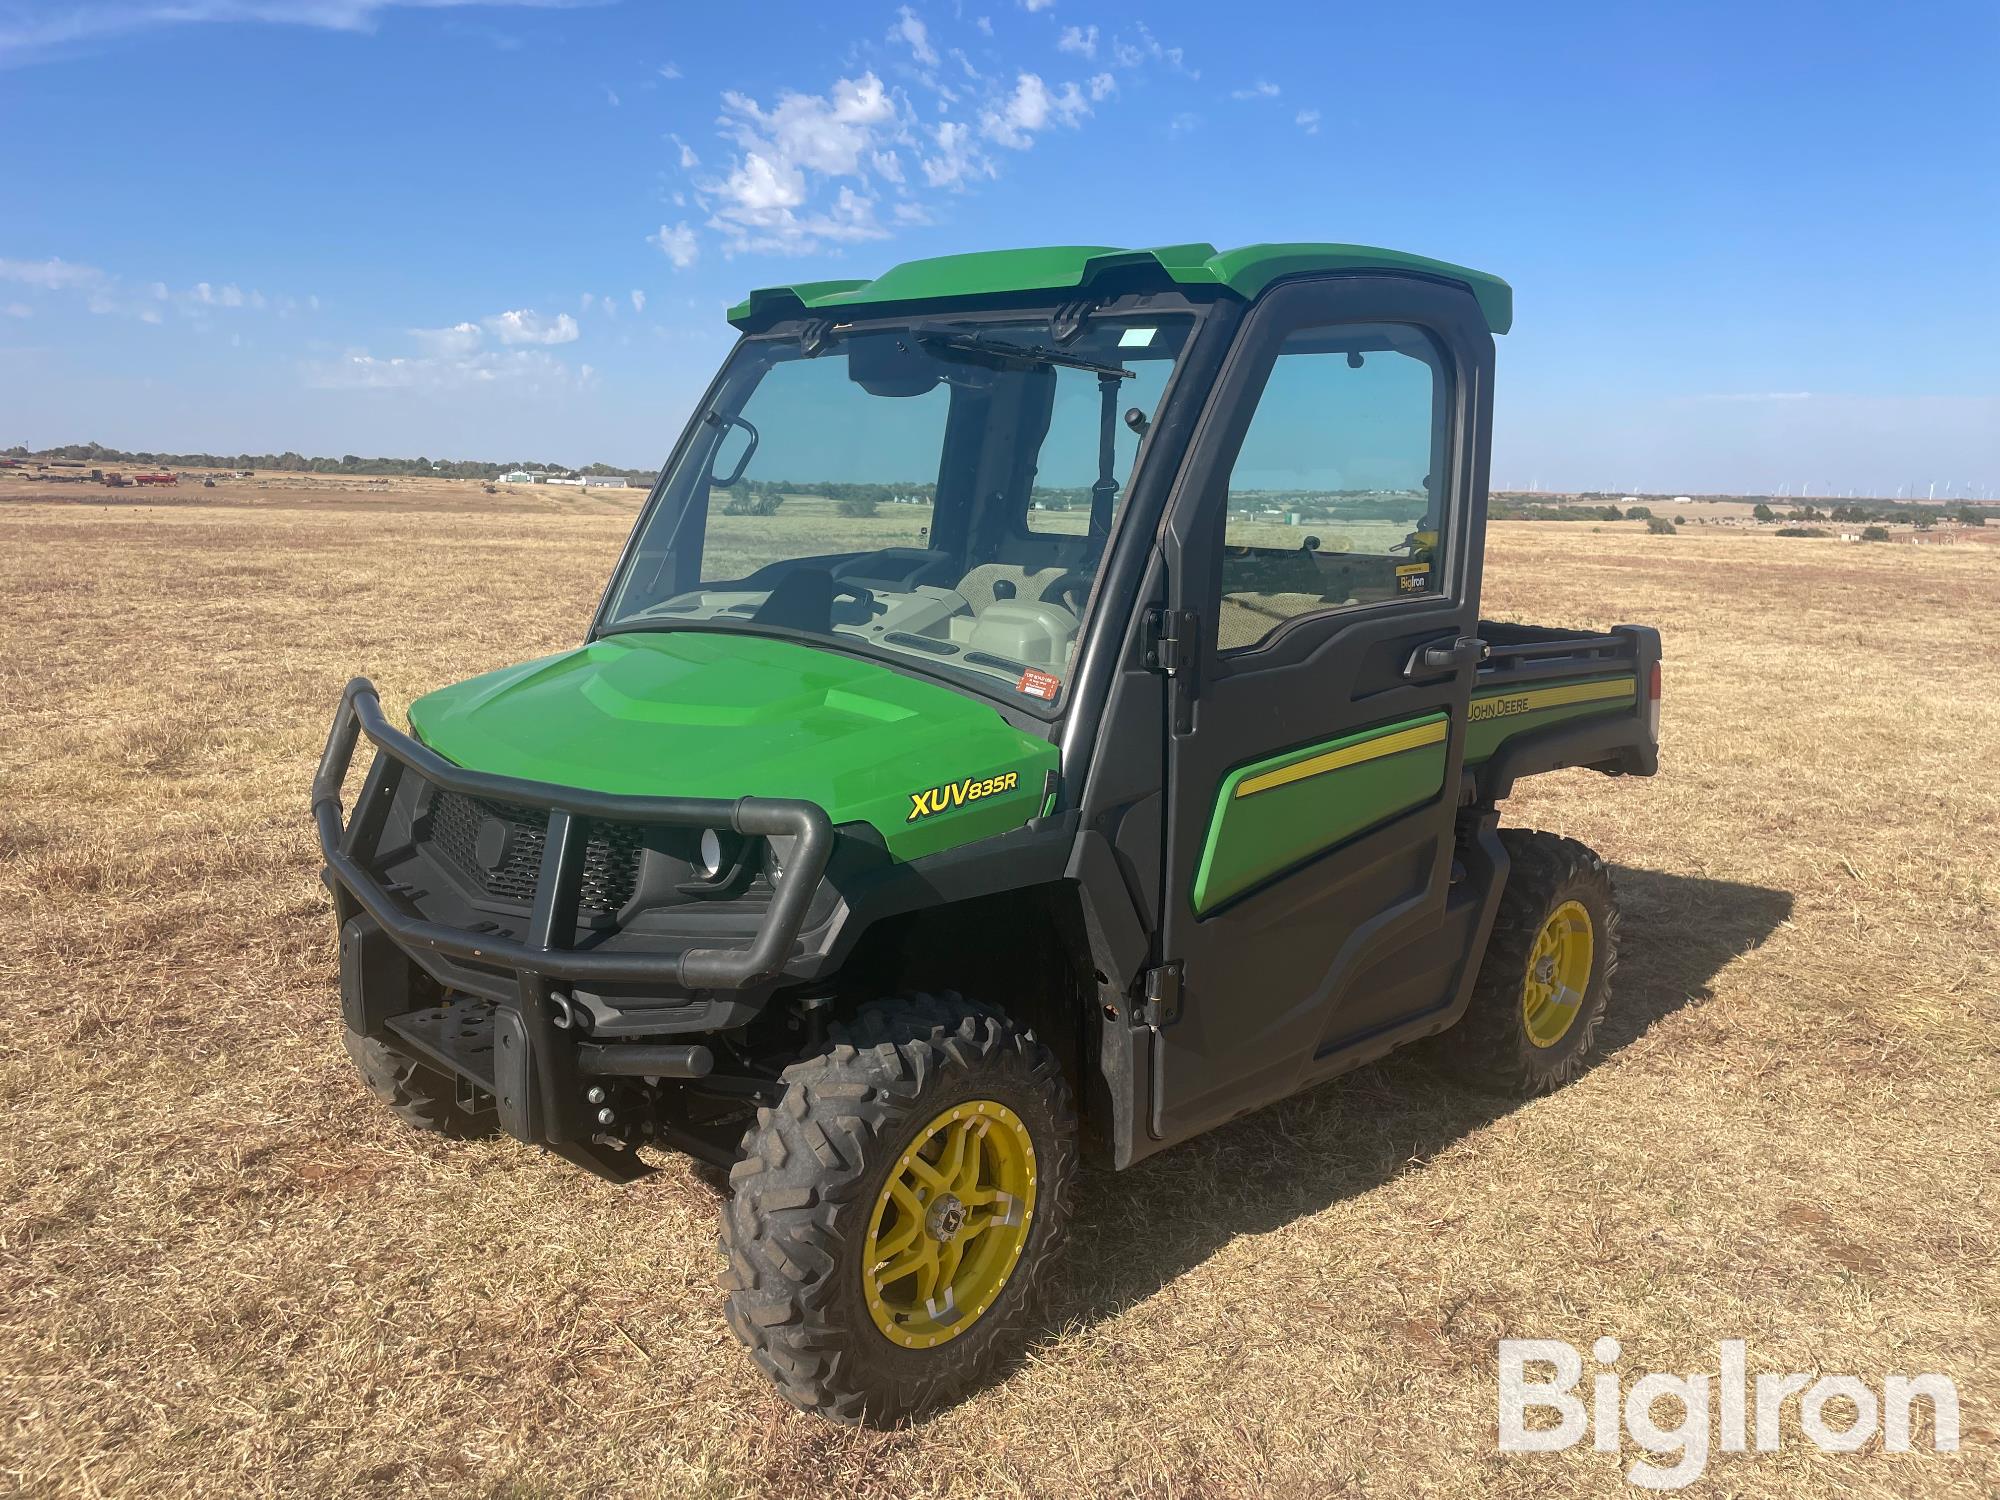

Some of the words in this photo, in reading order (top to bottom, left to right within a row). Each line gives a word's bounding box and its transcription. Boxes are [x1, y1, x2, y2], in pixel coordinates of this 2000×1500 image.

[1400, 576, 1425, 592] BigIron
[1468, 703, 1496, 720] JOHN
[1497, 698, 1529, 715] DEERE
